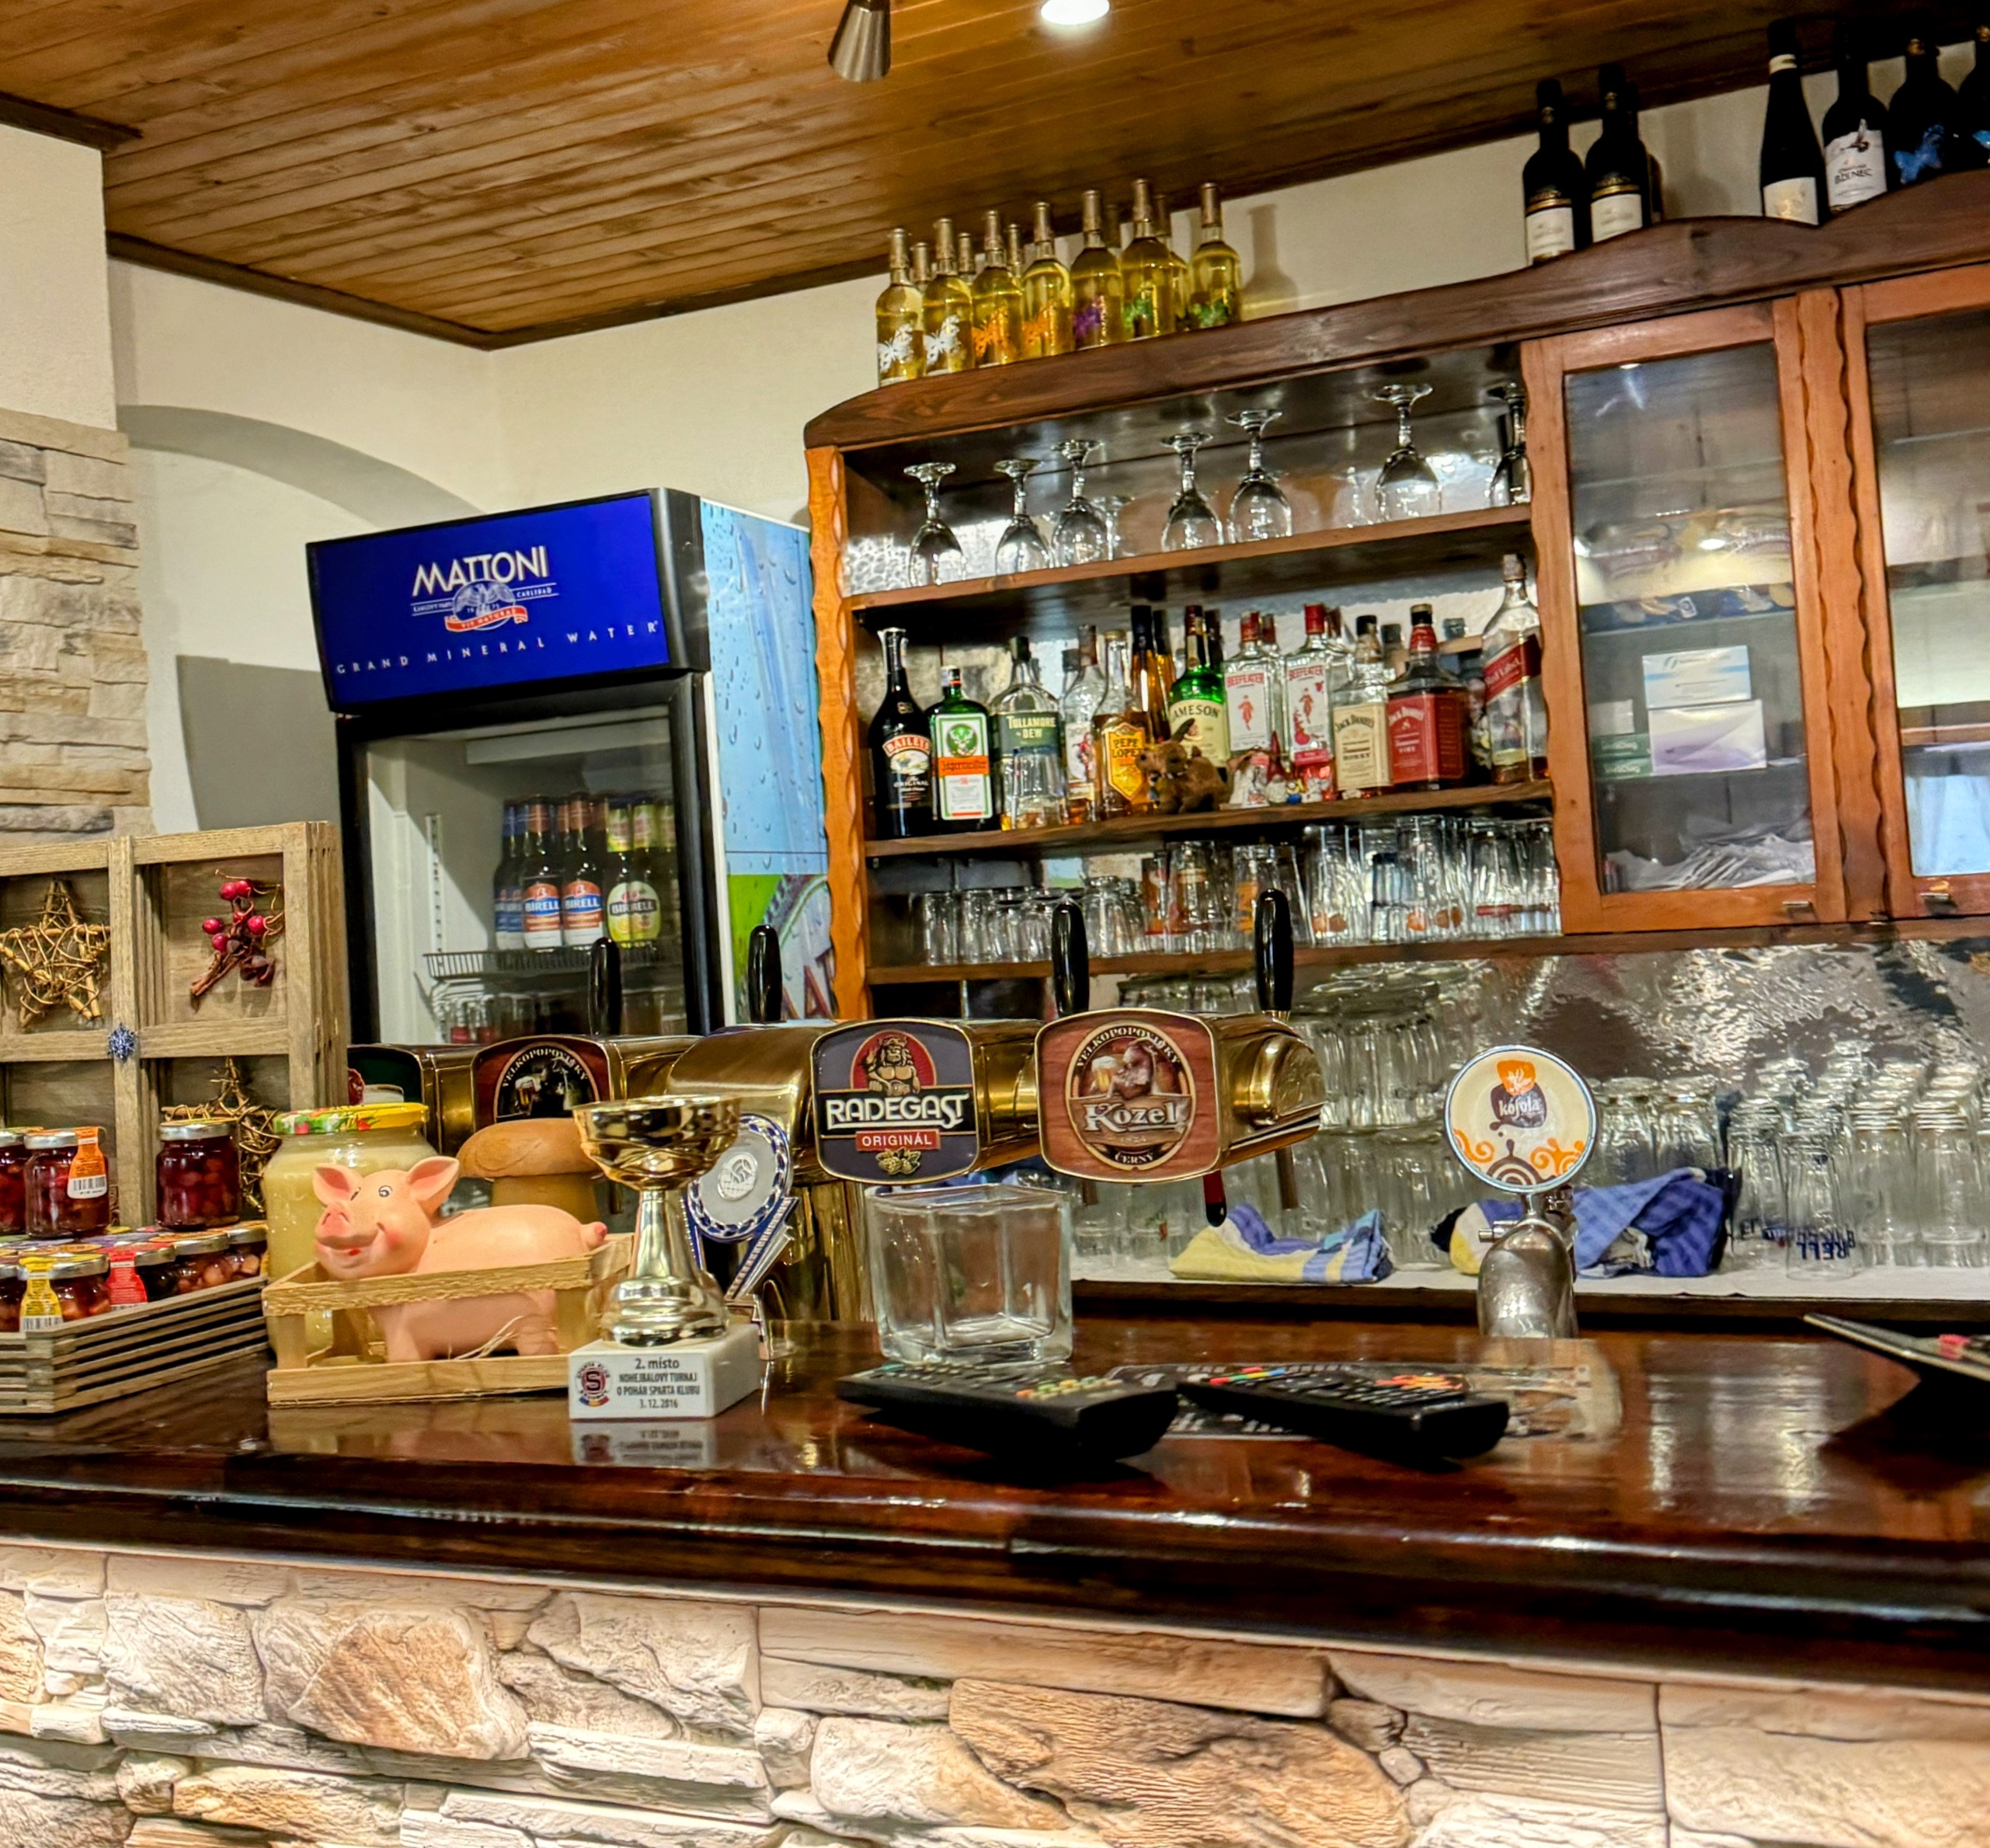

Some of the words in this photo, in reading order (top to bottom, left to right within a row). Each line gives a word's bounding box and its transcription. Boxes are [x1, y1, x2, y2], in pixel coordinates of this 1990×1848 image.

[412, 545, 549, 597] MATTONI
[336, 656, 409, 674] GRAND
[427, 637, 545, 663] MINERAL
[1289, 664, 1324, 681] BEEFEATER
[1226, 673, 1265, 688] BEEFEATER
[1007, 715, 1056, 729] TULLAMORE
[886, 736, 929, 753] BAILEYS
[1113, 738, 1139, 748] PEPE
[525, 900, 560, 913] BIRELL
[565, 898, 600, 910] BIRELL
[826, 1093, 969, 1130] RADEGAST
[1083, 1101, 1179, 1133] Kozel
[861, 1132, 932, 1147] ORIGINÁL
[635, 1358, 645, 1369] 2.
[648, 1356, 680, 1369] místo
[619, 1372, 668, 1383] NOHEJBALOVÝ
[670, 1372, 698, 1382] TURNAJ
[617, 1386, 622, 1396] O
[623, 1385, 648, 1396] POHÁR
[649, 1385, 675, 1396] SPARTA
[677, 1385, 700, 1395] KLUBU
